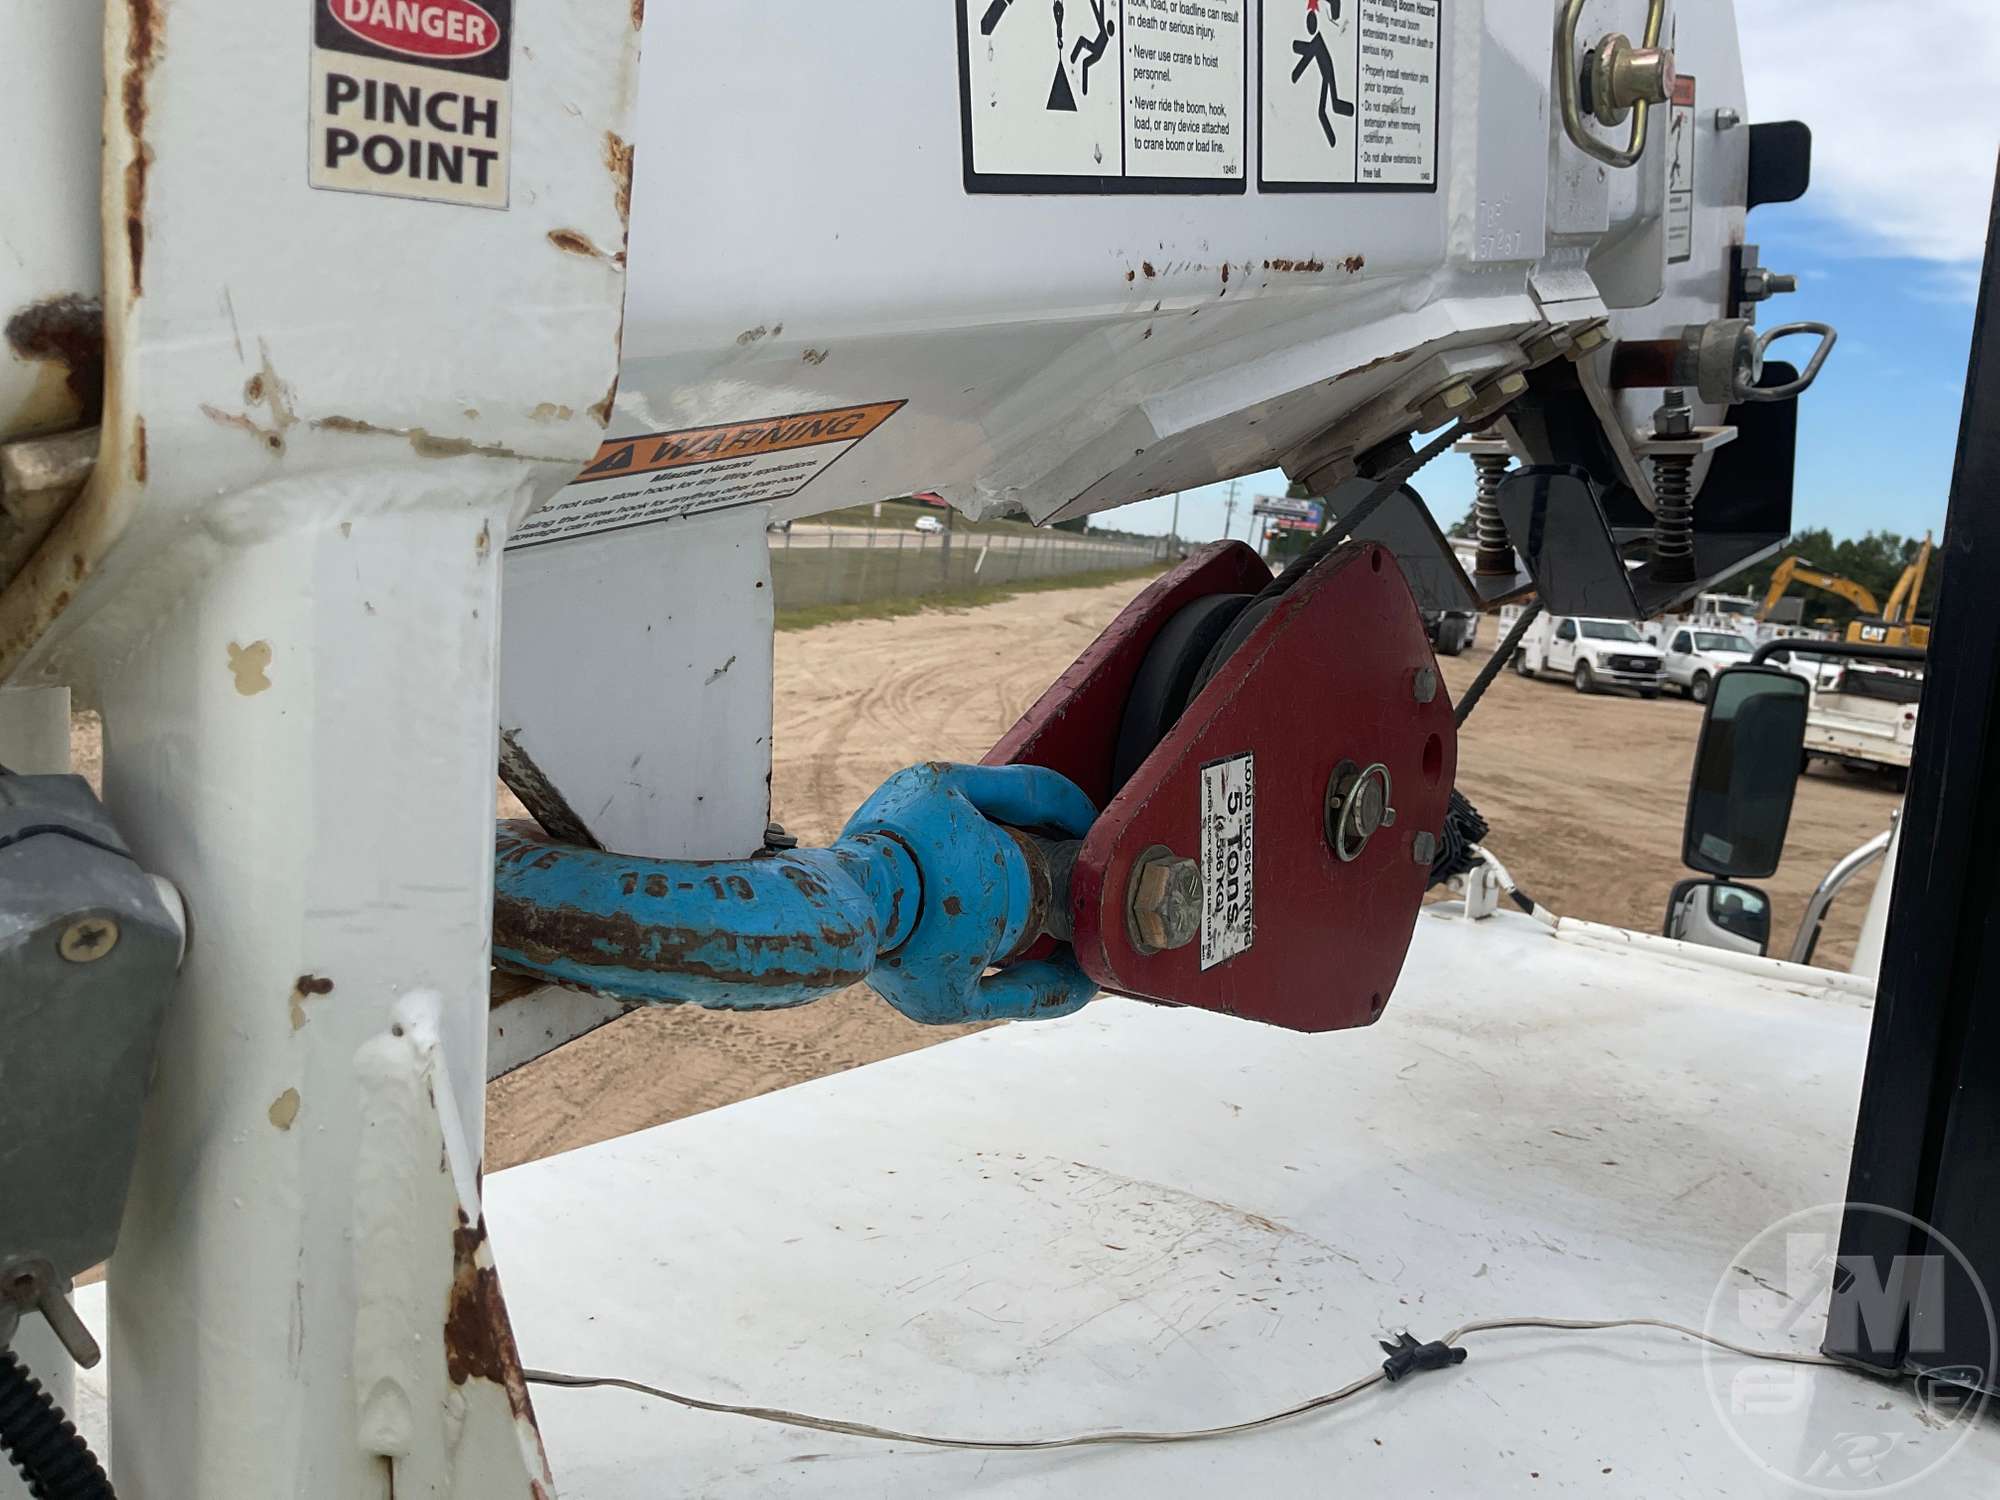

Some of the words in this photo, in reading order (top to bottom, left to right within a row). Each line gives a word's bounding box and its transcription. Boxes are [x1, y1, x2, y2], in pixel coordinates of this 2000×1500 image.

[344, 0, 486, 46] DANGER
[1170, 2, 1177, 12] or
[1180, 2, 1205, 17] loadline
[1207, 8, 1219, 20] can
[1221, 11, 1238, 22] result
[1128, 12, 1135, 25] in
[1137, 14, 1157, 29] death
[1160, 20, 1167, 31] or
[1169, 22, 1194, 35] serious
[1196, 24, 1215, 40] injury.
[1133, 45, 1156, 60] Never
[1158, 51, 1171, 62] use
[1173, 52, 1192, 64] crane
[1194, 54, 1201, 66] to
[1203, 54, 1218, 68] hoist
[1133, 68, 1171, 82] personnel.
[326, 72, 498, 138] PINCH
[1134, 96, 1157, 111] Never
[1159, 98, 1171, 112] ride
[1174, 99, 1184, 113] the
[1187, 100, 1207, 116] boom,
[1209, 102, 1227, 117] hook,
[1134, 115, 1151, 131] load,
[1154, 120, 1161, 130] or
[1163, 121, 1176, 134] any
[1178, 120, 1200, 133] device
[1202, 122, 1230, 135] attached
[1135, 137, 1141, 149] to
[1143, 139, 1163, 150] crane
[1166, 138, 1185, 151] boom
[1187, 141, 1194, 152] or
[1196, 139, 1209, 152] load
[1211, 140, 1224, 153] line.
[326, 127, 498, 187] POINT
[649, 412, 865, 463] WARNING
[650, 469, 703, 482] Misuse
[1861, 625, 1886, 641] CAT
[1228, 792, 1243, 815] 5
[1228, 825, 1243, 925] Tons
[1215, 875, 1224, 912] KG)
